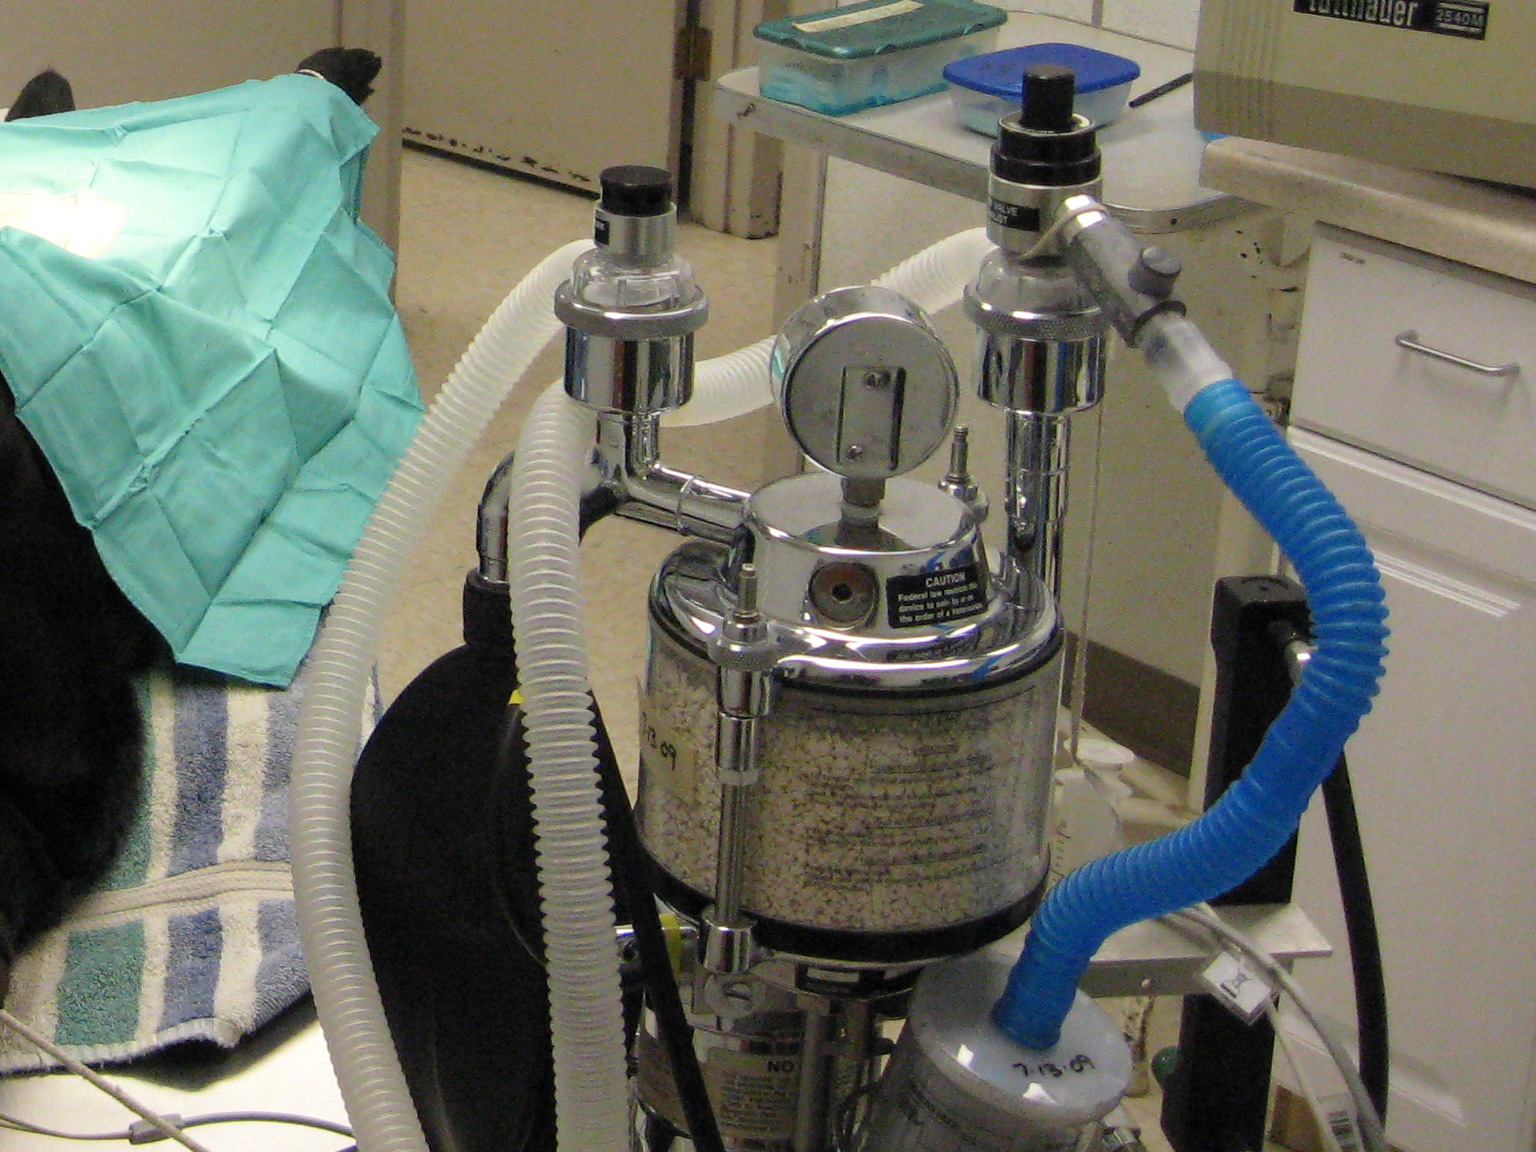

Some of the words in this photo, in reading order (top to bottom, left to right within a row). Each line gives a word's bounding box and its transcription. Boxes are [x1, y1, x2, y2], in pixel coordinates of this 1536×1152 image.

[1434, 7, 1484, 27] 2540M
[926, 572, 966, 587] CAUTION
[1013, 1054, 1096, 1078] 7-13-09
